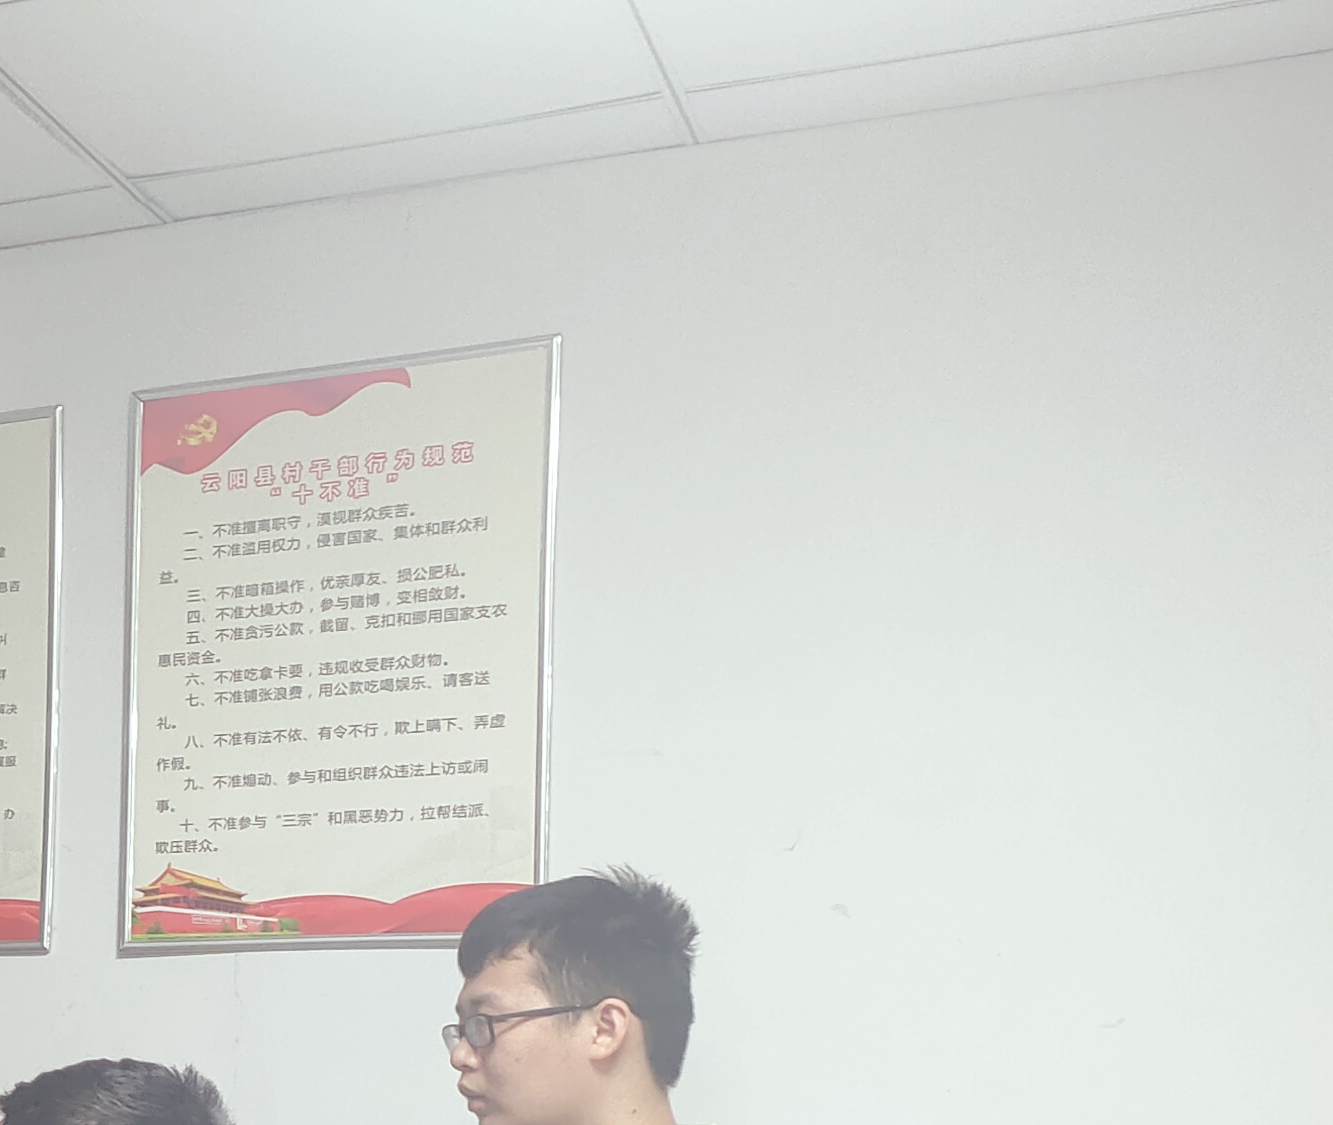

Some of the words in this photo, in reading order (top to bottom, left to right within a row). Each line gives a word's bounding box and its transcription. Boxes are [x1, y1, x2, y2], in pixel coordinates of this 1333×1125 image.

[201, 441, 475, 492] 云阳县村干部行为规范
